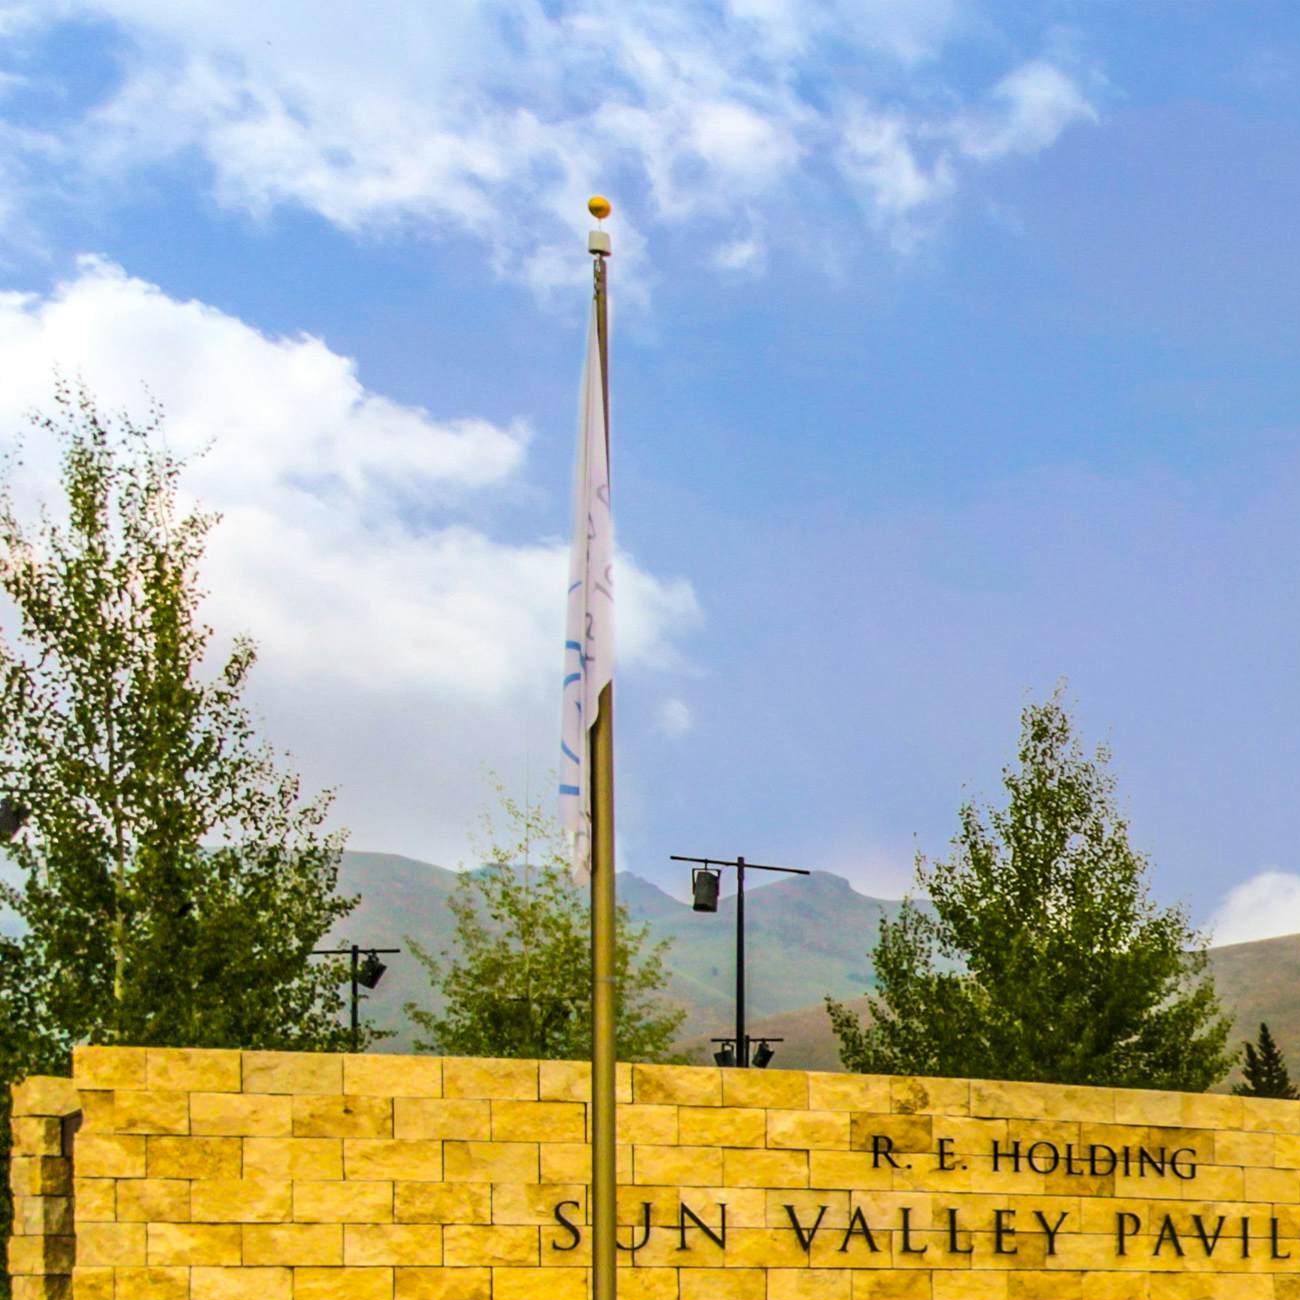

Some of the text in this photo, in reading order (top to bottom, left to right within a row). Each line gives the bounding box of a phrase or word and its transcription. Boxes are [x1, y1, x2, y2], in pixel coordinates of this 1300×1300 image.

[871, 1134, 1197, 1180] R. E. HOLDING
[783, 1204, 1069, 1256] VALLEY
